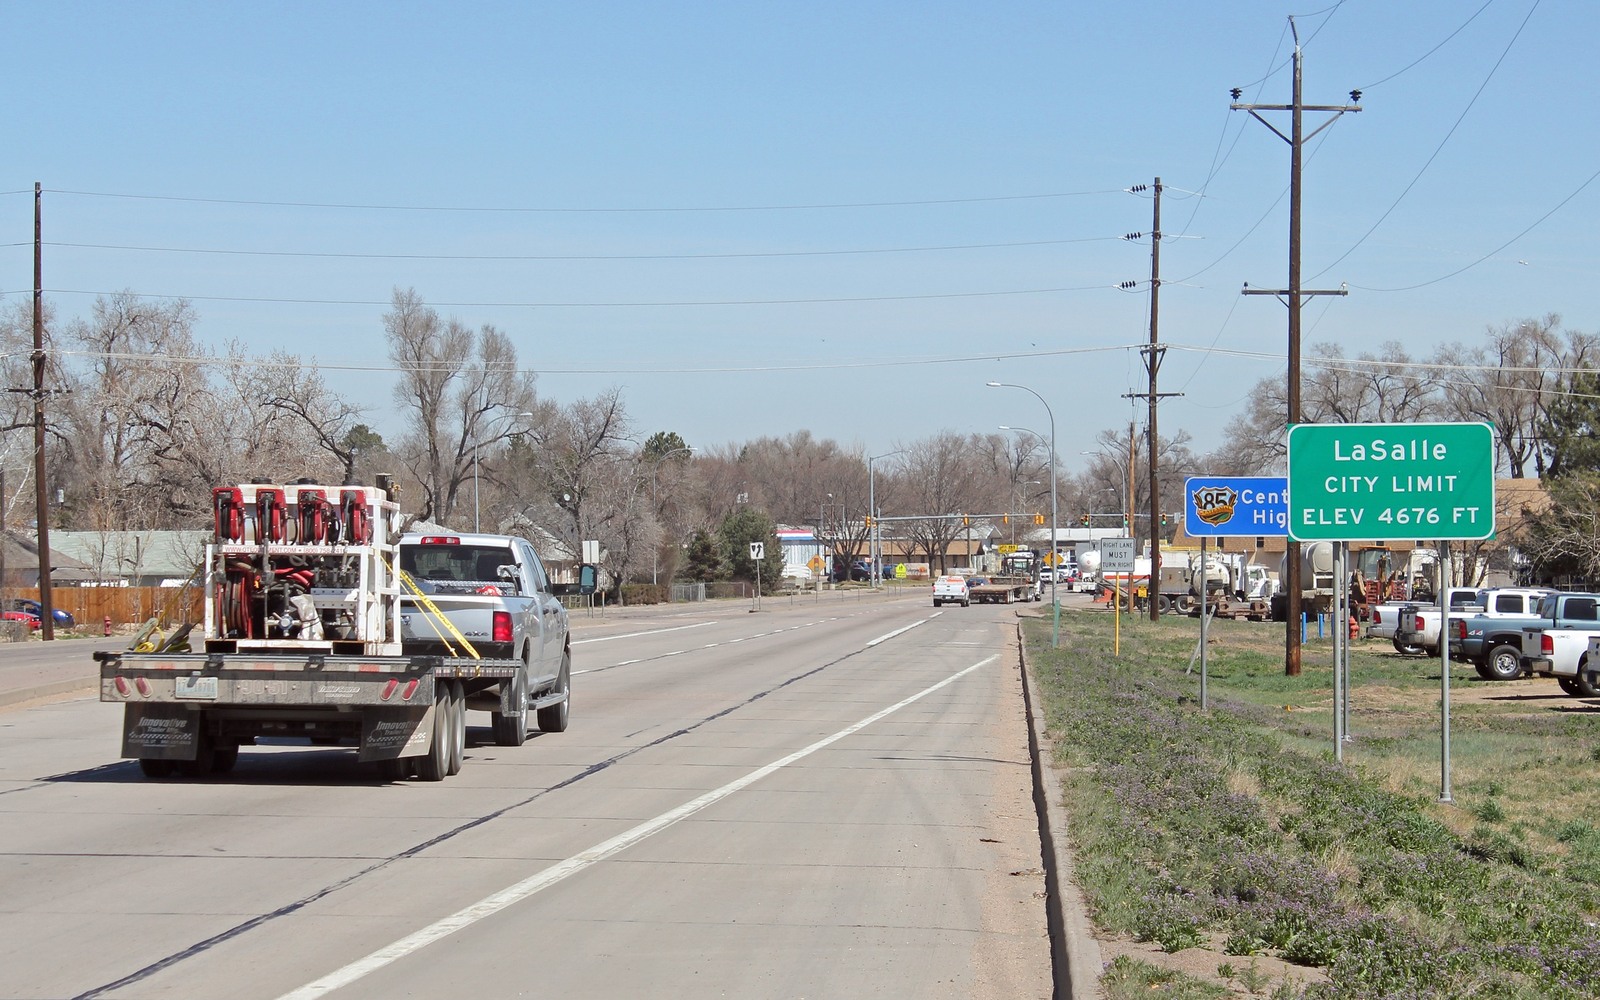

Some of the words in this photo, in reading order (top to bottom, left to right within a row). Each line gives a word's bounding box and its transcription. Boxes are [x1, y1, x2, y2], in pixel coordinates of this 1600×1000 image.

[1334, 439, 1447, 461] LaSalle
[1324, 476, 1379, 493] CITY
[1392, 475, 1457, 492] LIMIT
[1203, 492, 1228, 510] 85
[1241, 489, 1288, 504] Cent
[1253, 509, 1286, 529] Hig
[1303, 508, 1364, 525] ELEV
[1377, 507, 1440, 525] 4676
[1452, 507, 1479, 524] FT
[1108, 551, 1128, 559] MUST
[138, 716, 188, 728] Innovative
